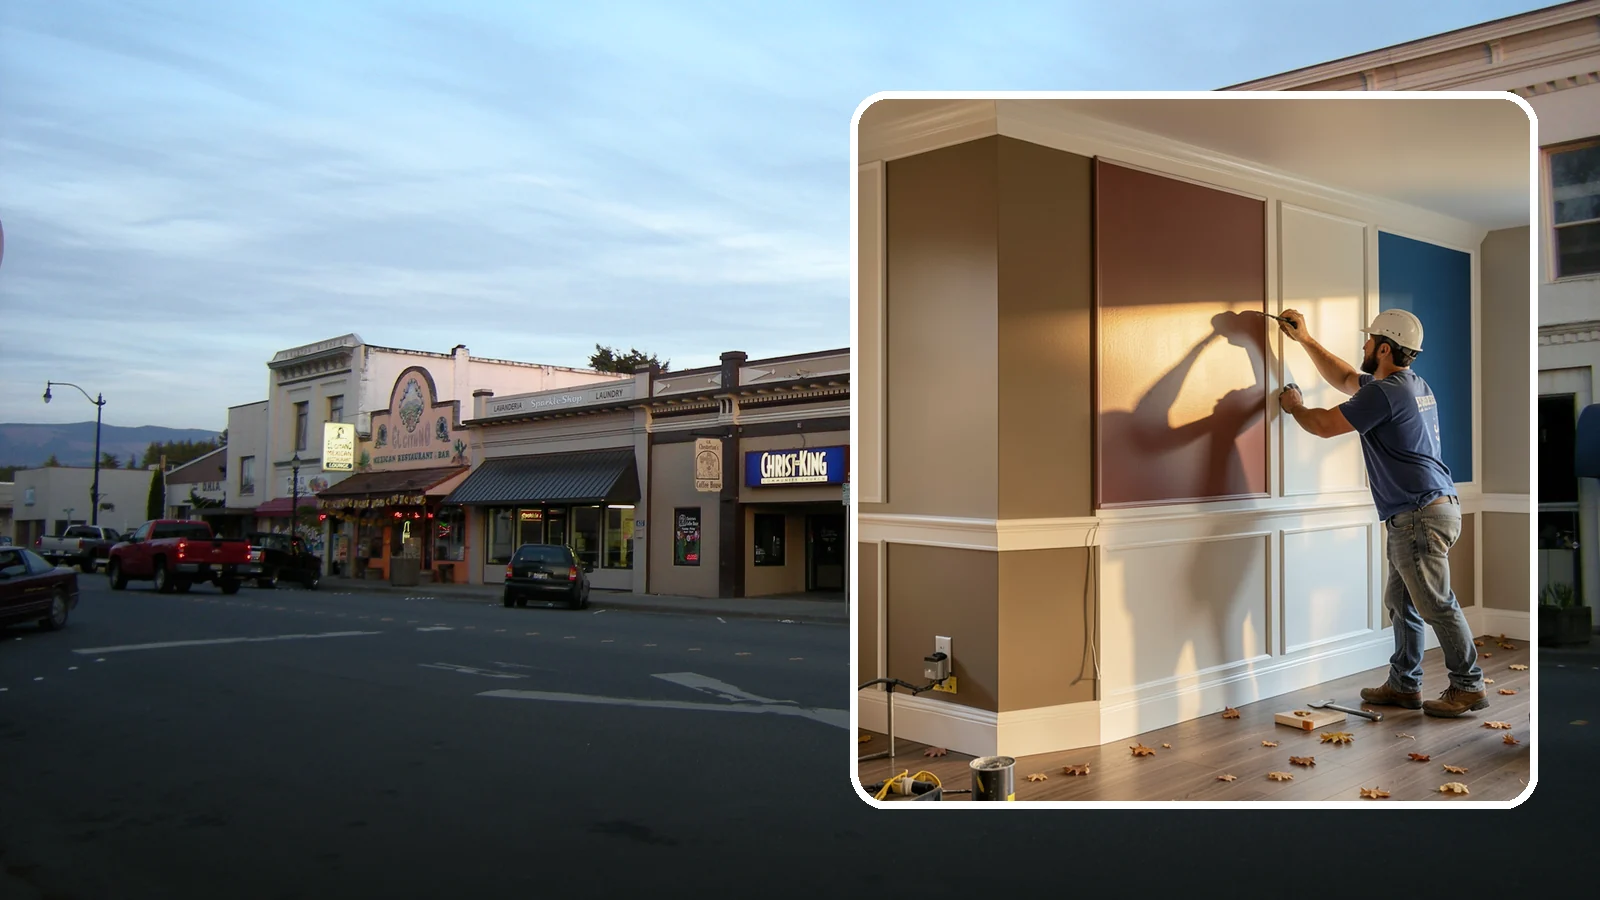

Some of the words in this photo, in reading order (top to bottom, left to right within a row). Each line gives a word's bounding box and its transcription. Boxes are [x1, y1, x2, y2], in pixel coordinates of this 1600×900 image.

[562, 394, 583, 405] Shop
[595, 389, 623, 400] LAUNDRY
[493, 402, 523, 412] LAVANDERIA
[398, 452, 433, 462] RESTAURANT
[438, 450, 450, 459] BAR
[799, 450, 827, 476] KING
[696, 480, 709, 489] Coffee
